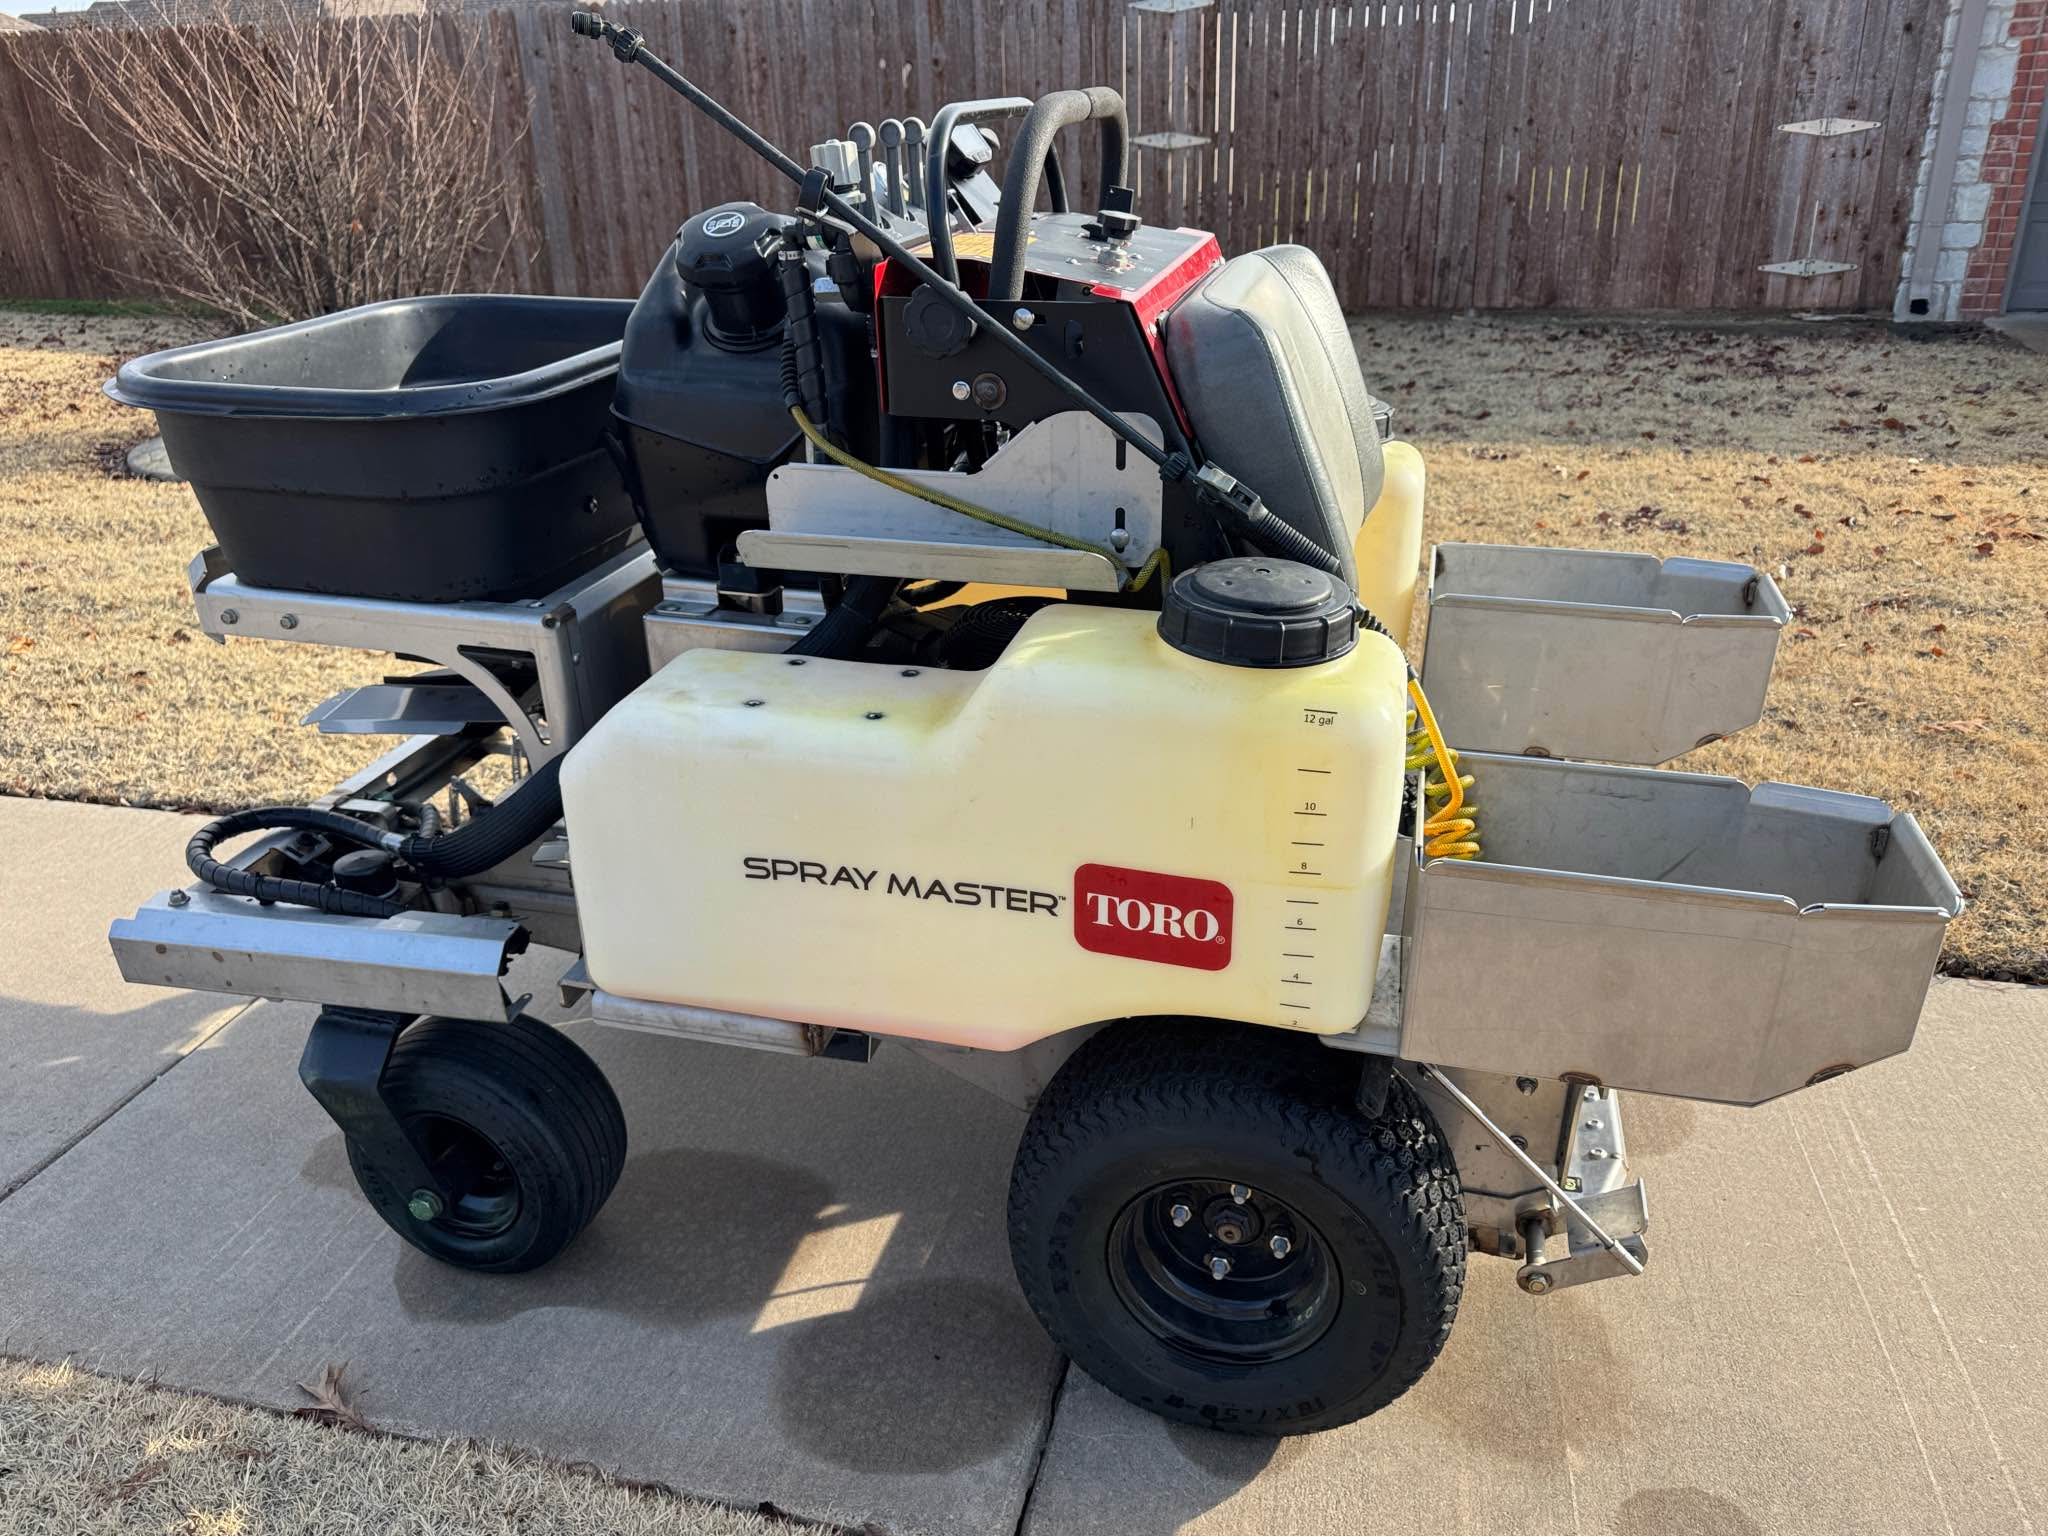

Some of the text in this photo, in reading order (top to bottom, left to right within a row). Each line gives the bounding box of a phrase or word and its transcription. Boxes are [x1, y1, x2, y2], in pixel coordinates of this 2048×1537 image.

[1304, 714, 1334, 727] 12 gal
[1304, 802, 1316, 811] 10
[1301, 862, 1307, 870] 8
[743, 856, 878, 891] SPRAY
[1297, 918, 1303, 926] 6
[1293, 972, 1299, 980] 4
